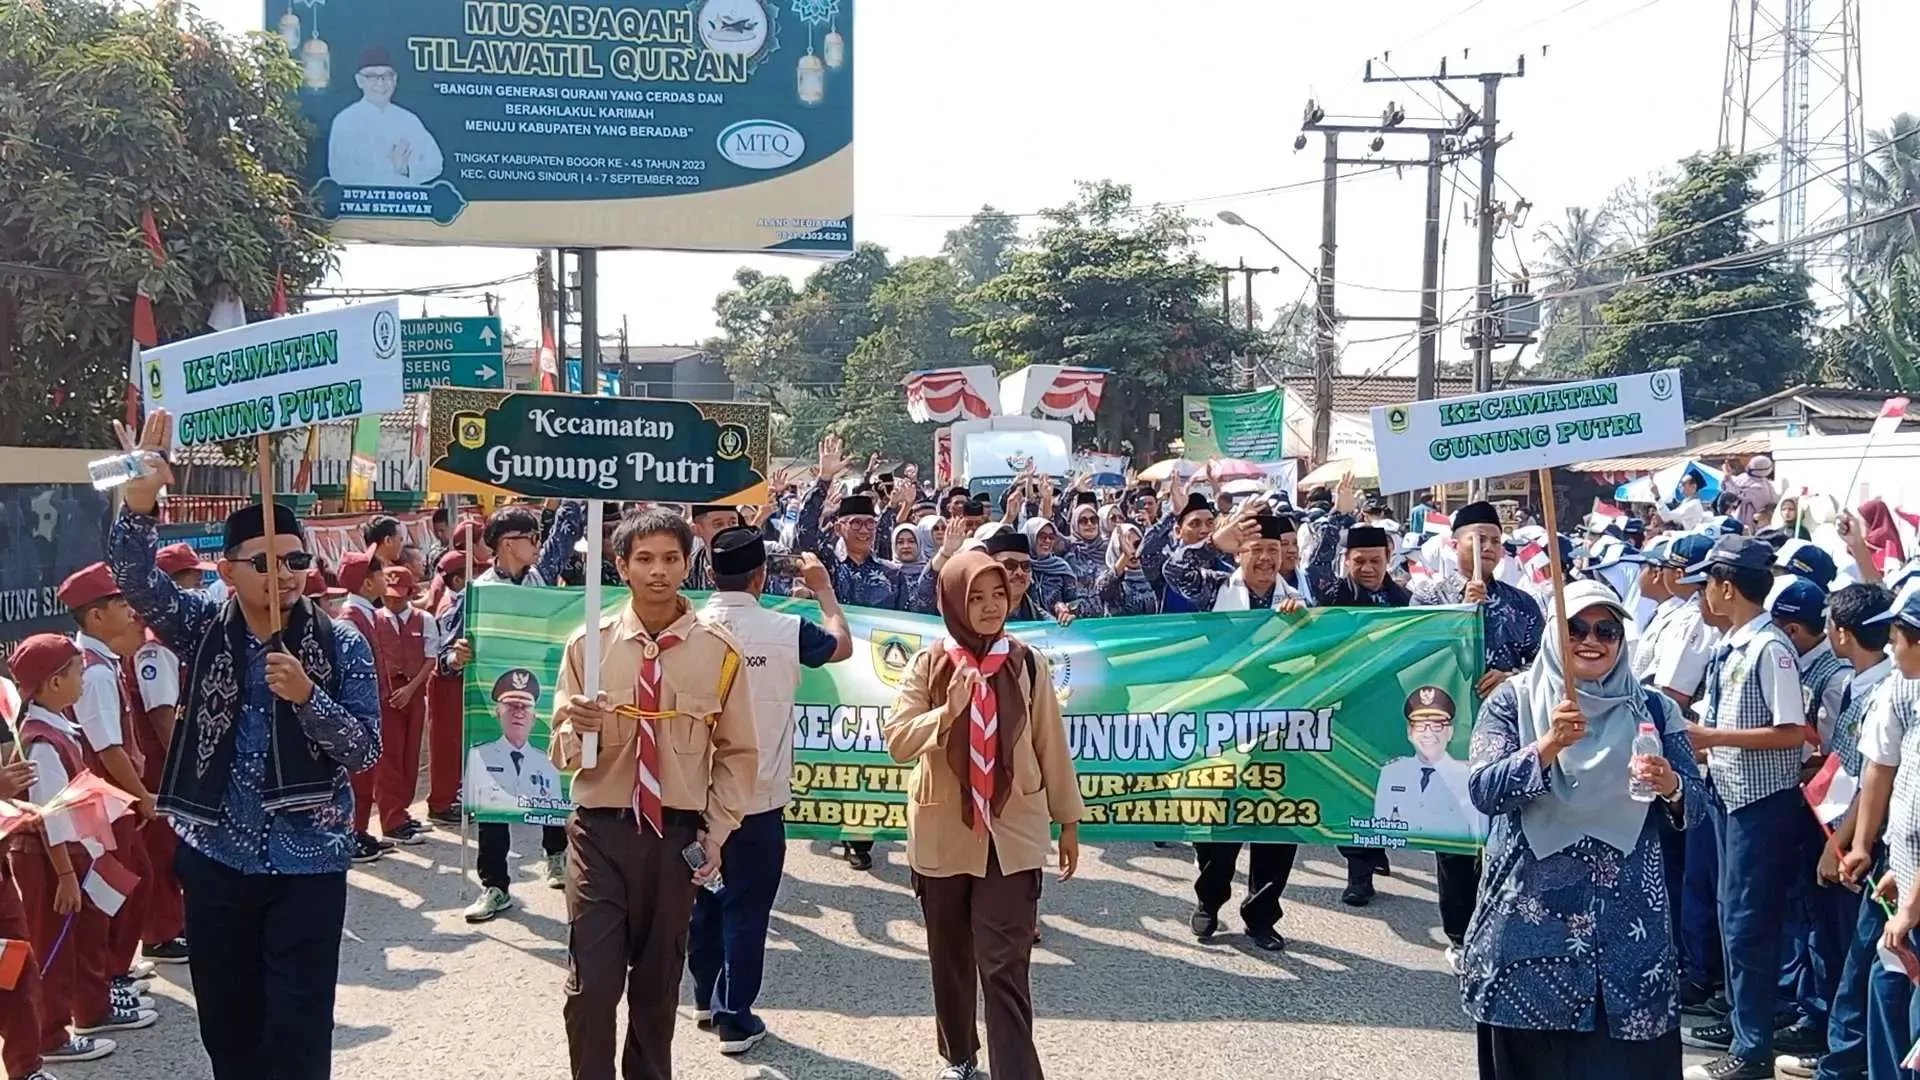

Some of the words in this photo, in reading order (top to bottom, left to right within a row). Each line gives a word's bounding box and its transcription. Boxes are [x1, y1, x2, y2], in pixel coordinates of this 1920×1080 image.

[465, 1, 692, 43] MUSABAQAH
[408, 37, 603, 78] TILAWATIL
[434, 83, 493, 96] "BANGUN
[495, 85, 558, 98] GENERASI
[560, 88, 608, 101] QURANI
[609, 90, 643, 101] YANG
[645, 91, 695, 103] CERDAS
[698, 93, 723, 104] DAN
[505, 103, 597, 117] BERAKHLAKUL
[599, 107, 654, 119] KARIMAH
[465, 120, 516, 132] MENUJU
[519, 122, 591, 136] KABUPATEN
[593, 125, 627, 136] YANG
[630, 126, 694, 138] BERADAB"
[736, 133, 794, 157] MTQ
[454, 152, 499, 163] TINGKAT
[501, 154, 563, 166] KABUPATEN
[566, 156, 606, 168] BOGOR
[607, 158, 622, 168] KE
[630, 159, 643, 169] 45
[645, 159, 680, 170] TAHUN
[682, 160, 706, 170] 2023
[460, 169, 486, 179] KEC.
[488, 169, 535, 181] GUNUNG
[538, 171, 578, 182] SINDUR
[586, 174, 592, 182] 4
[602, 174, 608, 183] 7
[609, 174, 674, 185] SEPTEMBER
[676, 175, 700, 185] 2023
[343, 189, 386, 200] BUPATI
[387, 190, 429, 201] BOGOR
[340, 202, 371, 212] IWAN
[372, 203, 432, 214] SETIAWAN
[401, 321, 463, 336] RUMPUNG
[401, 338, 454, 352] ERPONG
[183, 329, 337, 394] KECAMATAN
[404, 376, 451, 390] EMANG
[179, 395, 275, 446] GUNUNG
[280, 379, 362, 427] PUTRI
[1438, 382, 1618, 427] KECAMATAN
[528, 408, 674, 441] Kecamatan
[1429, 424, 1551, 462] GUNUNG
[1556, 412, 1643, 443] PUTRI
[486, 445, 618, 489] Gunung
[626, 451, 715, 485] Putri
[0, 590, 38, 622] UNG
[745, 656, 767, 667] OGOR
[794, 704, 890, 753] KECA
[1062, 711, 1197, 762] UNUNG
[1205, 707, 1335, 758] PUTRI
[790, 762, 861, 795] QAH
[1077, 770, 1181, 799] UR'AN
[1185, 764, 1238, 789] KE
[1241, 761, 1285, 790] 45
[783, 797, 907, 828] KABUPA
[1111, 798, 1228, 825] TAHUN
[1236, 798, 1320, 826] 2023
[1350, 817, 1370, 828] Iwan
[1371, 818, 1408, 830] Setiawan
[1353, 833, 1381, 847] Bupati
[1381, 835, 1406, 849] Bogor
